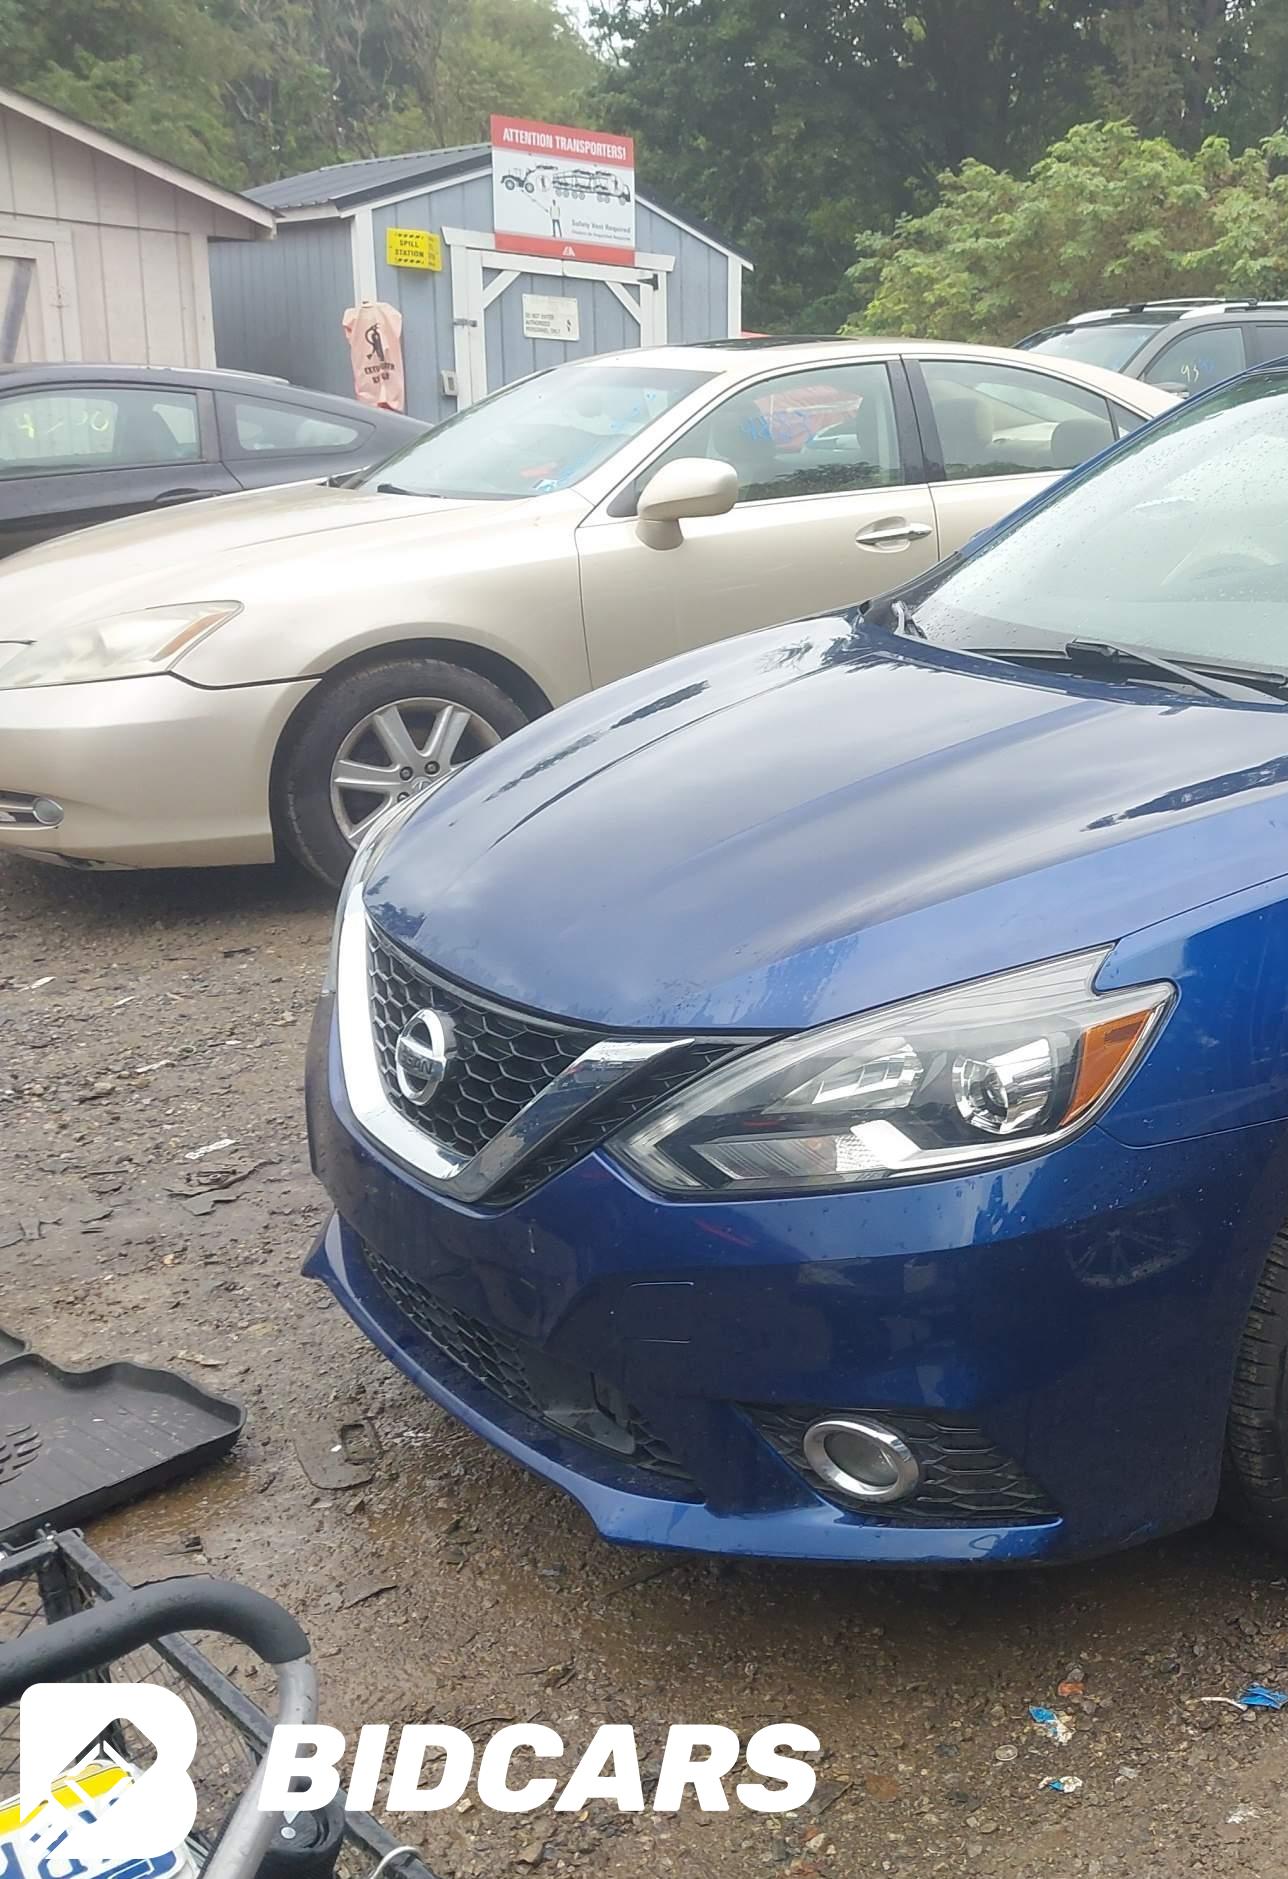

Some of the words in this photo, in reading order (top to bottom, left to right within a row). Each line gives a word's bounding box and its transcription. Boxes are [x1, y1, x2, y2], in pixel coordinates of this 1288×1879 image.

[503, 128, 553, 149] ATTENTION
[555, 135, 626, 160] TRANSPORTERS!
[399, 239, 420, 249] SPILL
[395, 248, 424, 258] STATION
